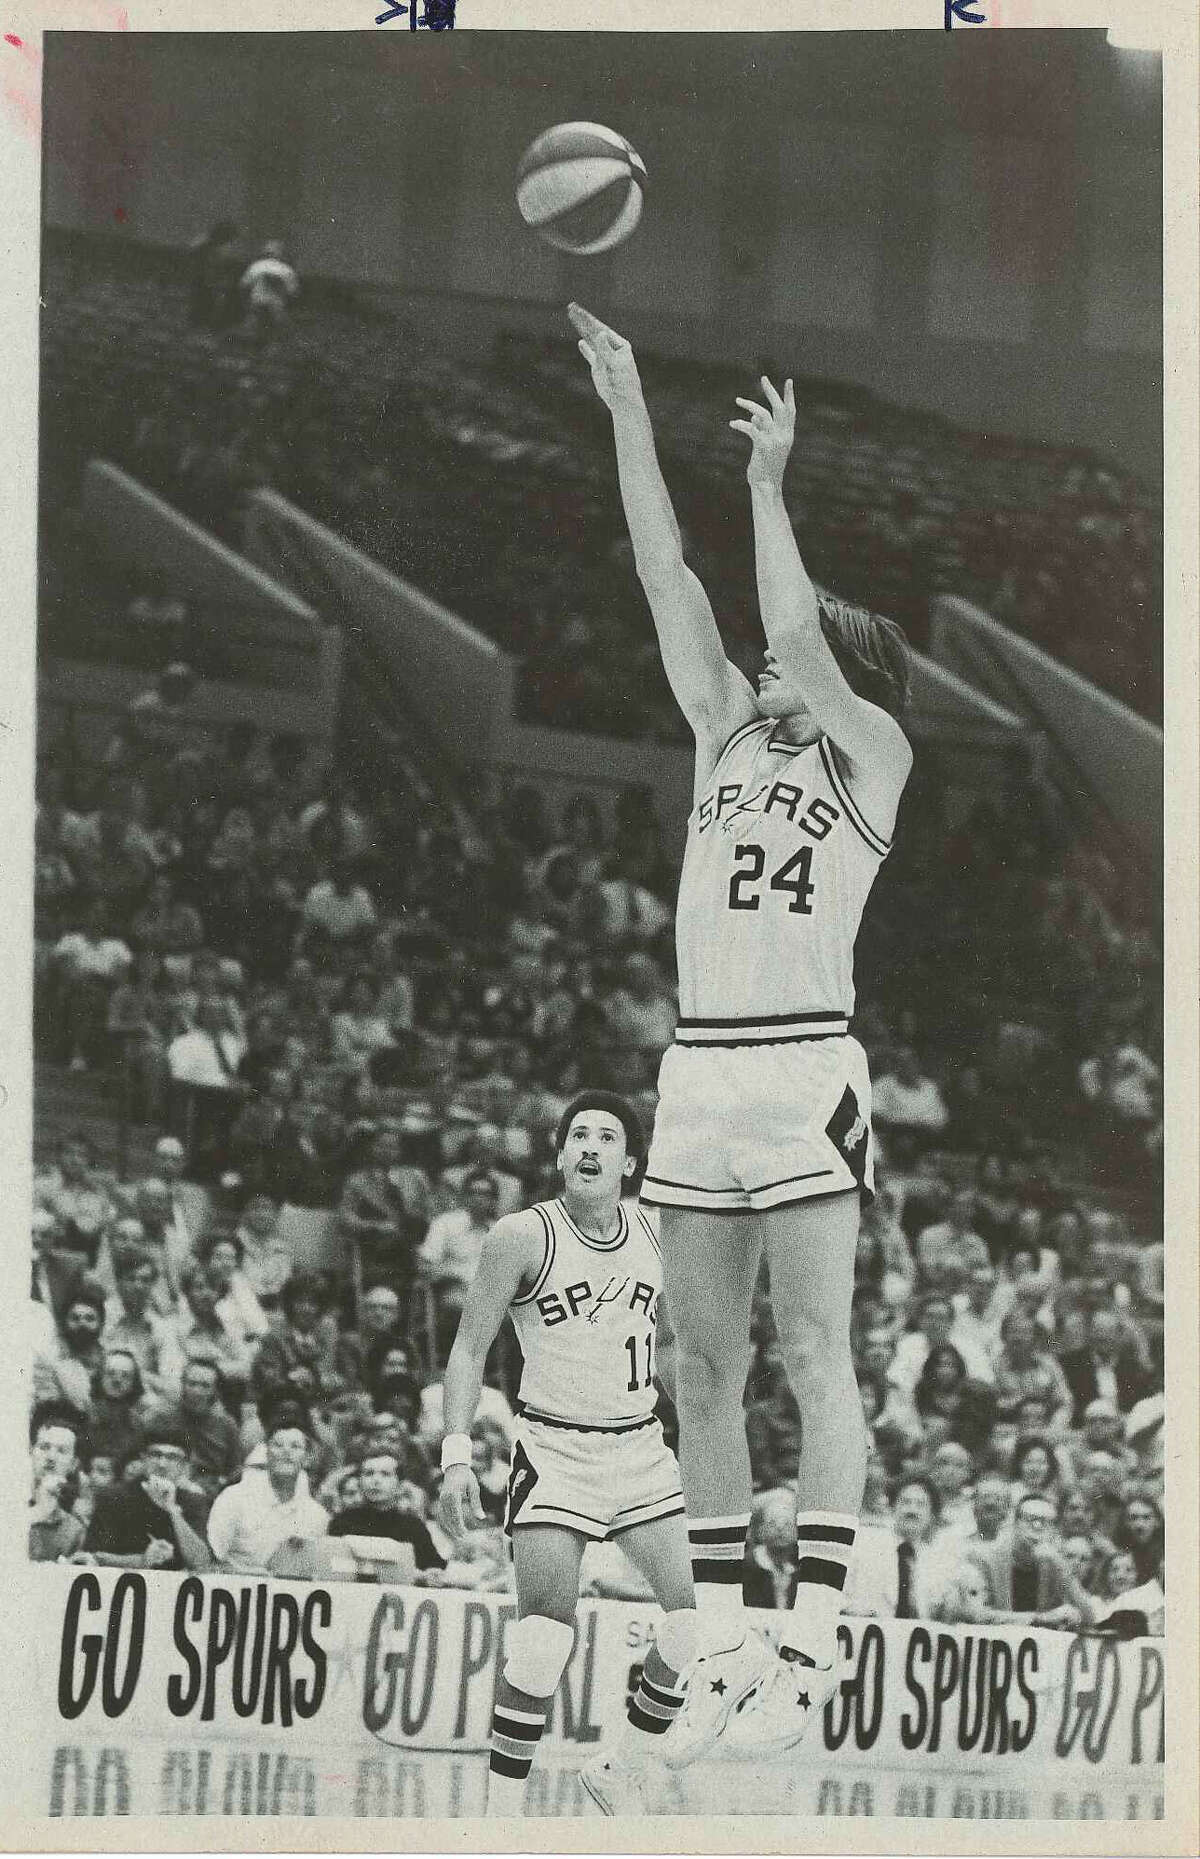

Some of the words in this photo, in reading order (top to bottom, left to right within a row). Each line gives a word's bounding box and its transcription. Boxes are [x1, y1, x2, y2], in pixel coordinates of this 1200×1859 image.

[699, 781, 840, 841] SPURS
[728, 844, 815, 915] 24
[624, 1332, 652, 1392] 11
[58, 1572, 147, 1720] GO
[167, 1576, 332, 1728] SPURS
[363, 1592, 440, 1737] GO
[823, 1623, 885, 1751] GO
[900, 1626, 1038, 1755] SPURS
[1055, 1637, 1121, 1764] GO
